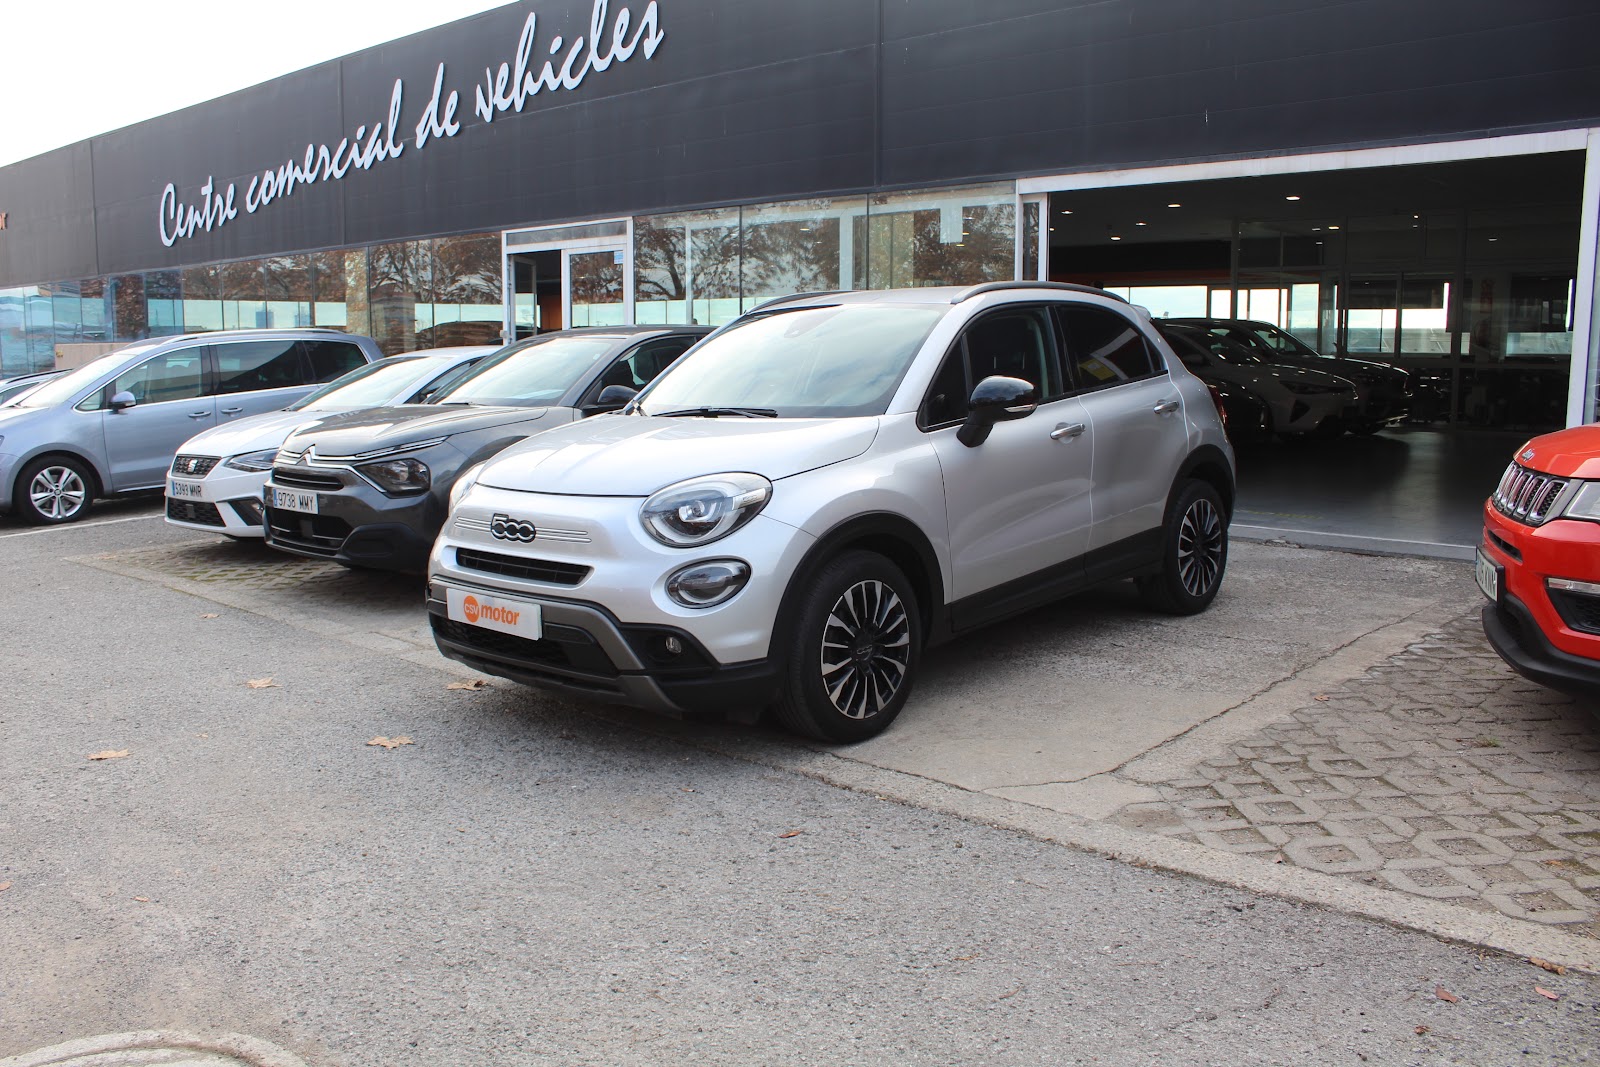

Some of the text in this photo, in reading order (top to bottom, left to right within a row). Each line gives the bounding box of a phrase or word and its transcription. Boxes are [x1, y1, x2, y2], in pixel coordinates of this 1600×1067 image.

[159, 0, 664, 247] Centre comercial de vehicles
[278, 492, 314, 511] 9738 MMY
[491, 514, 536, 543] 500
[464, 603, 519, 625] CSV motor
